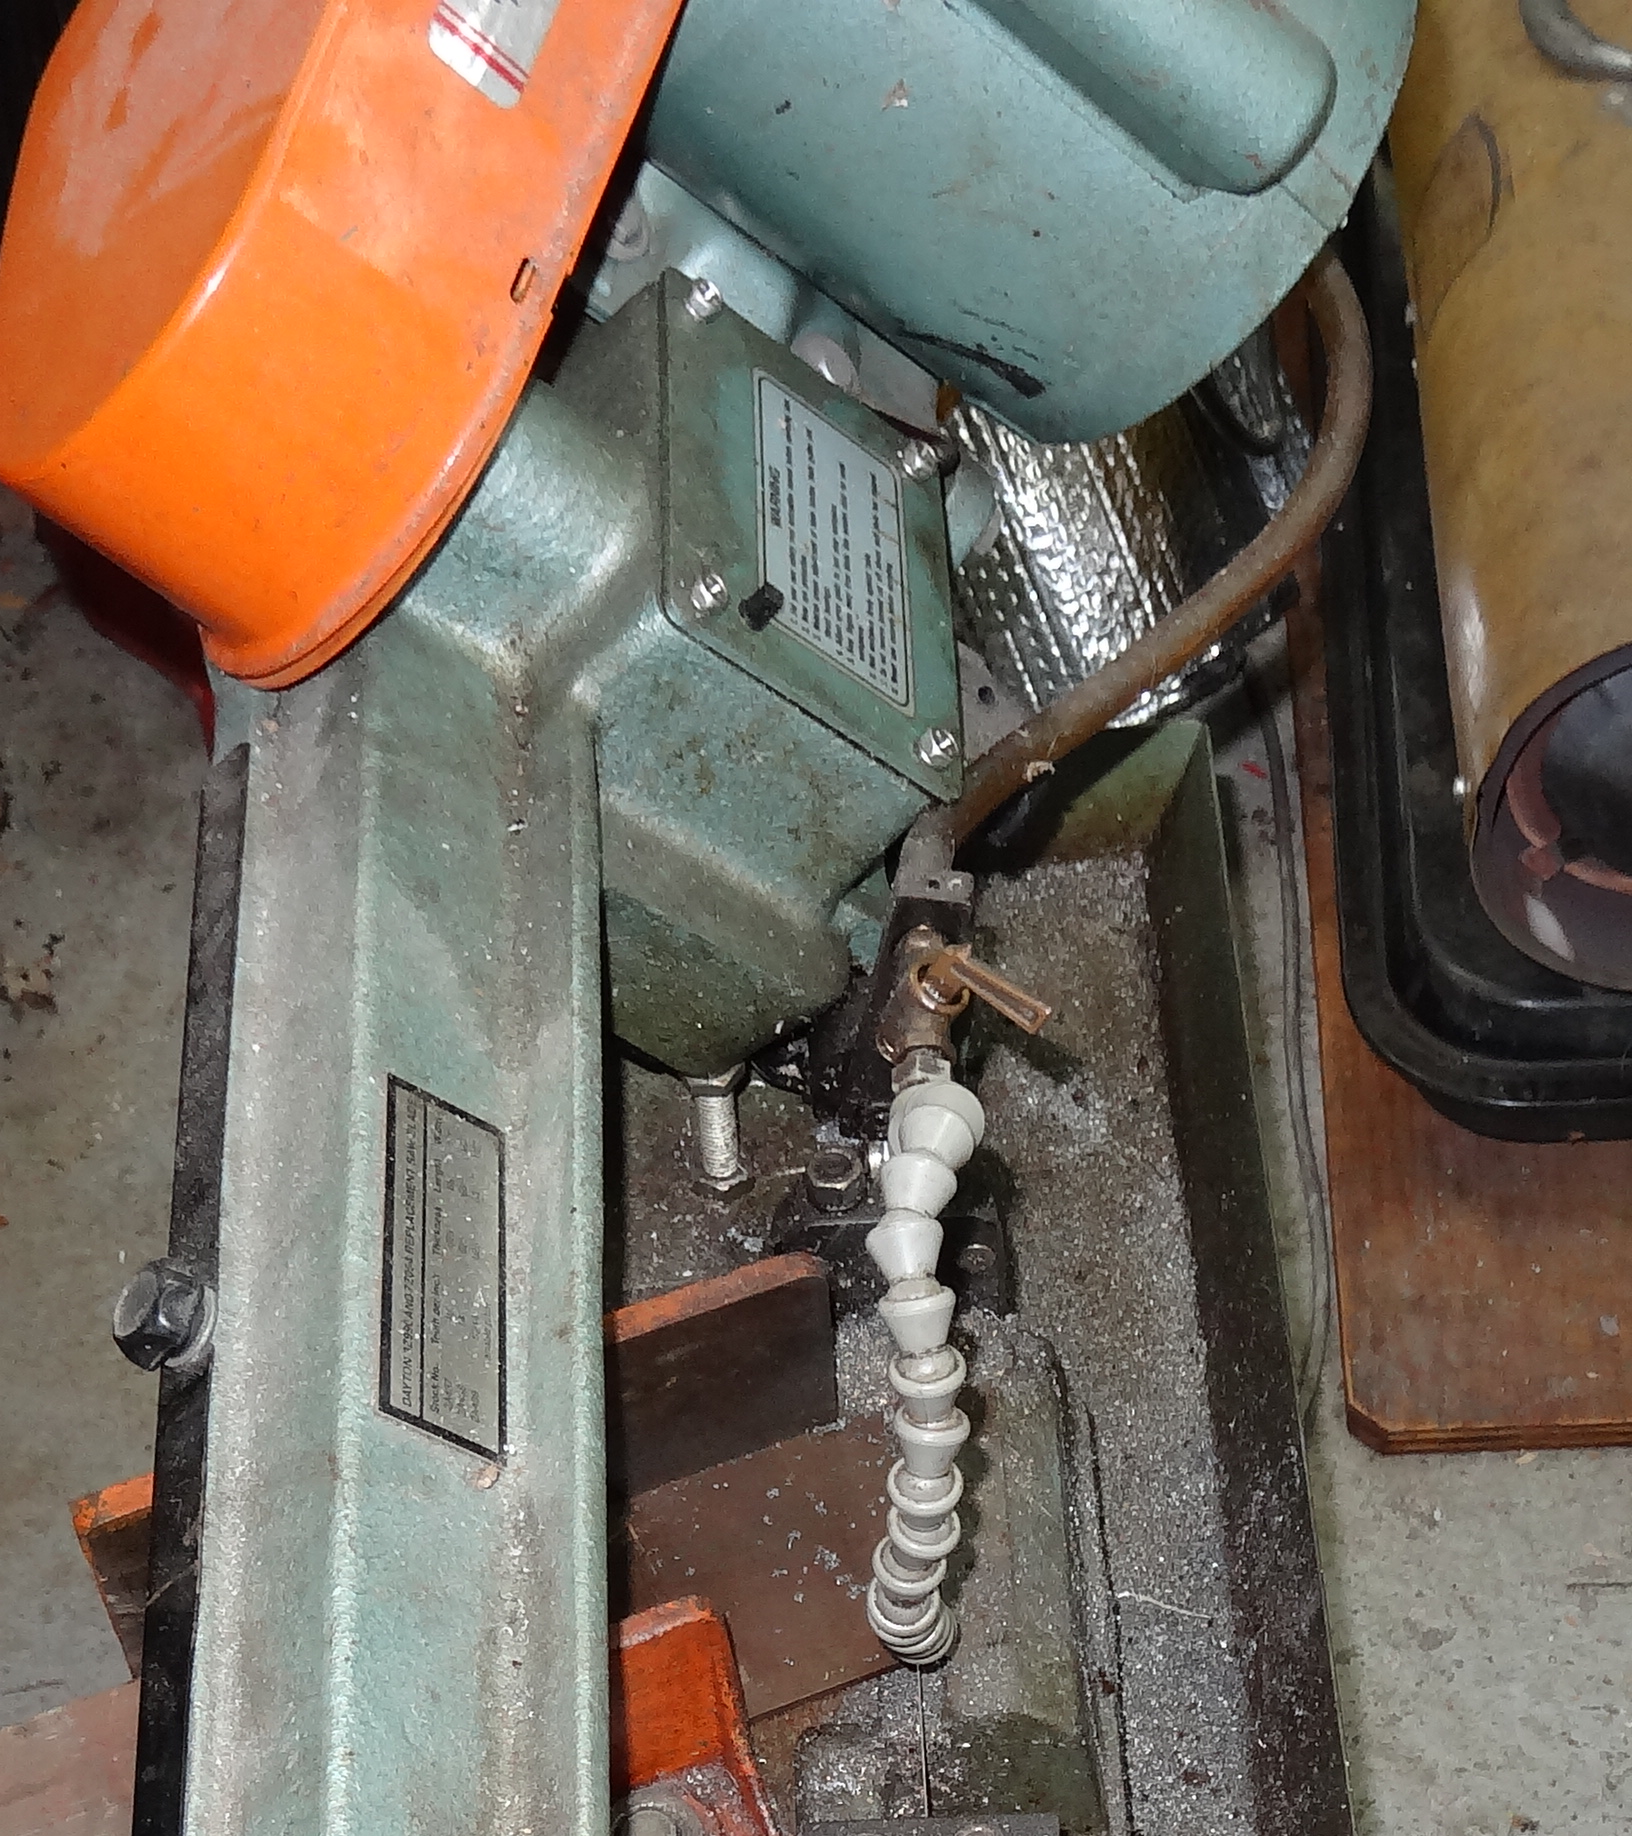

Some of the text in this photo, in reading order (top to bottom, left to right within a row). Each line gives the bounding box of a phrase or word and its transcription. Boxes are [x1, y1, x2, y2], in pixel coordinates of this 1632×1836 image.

[769, 465, 782, 528] WARNING
[404, 1171, 417, 1255] REPLACEMENT
[402, 1355, 414, 1408] DAYTON
